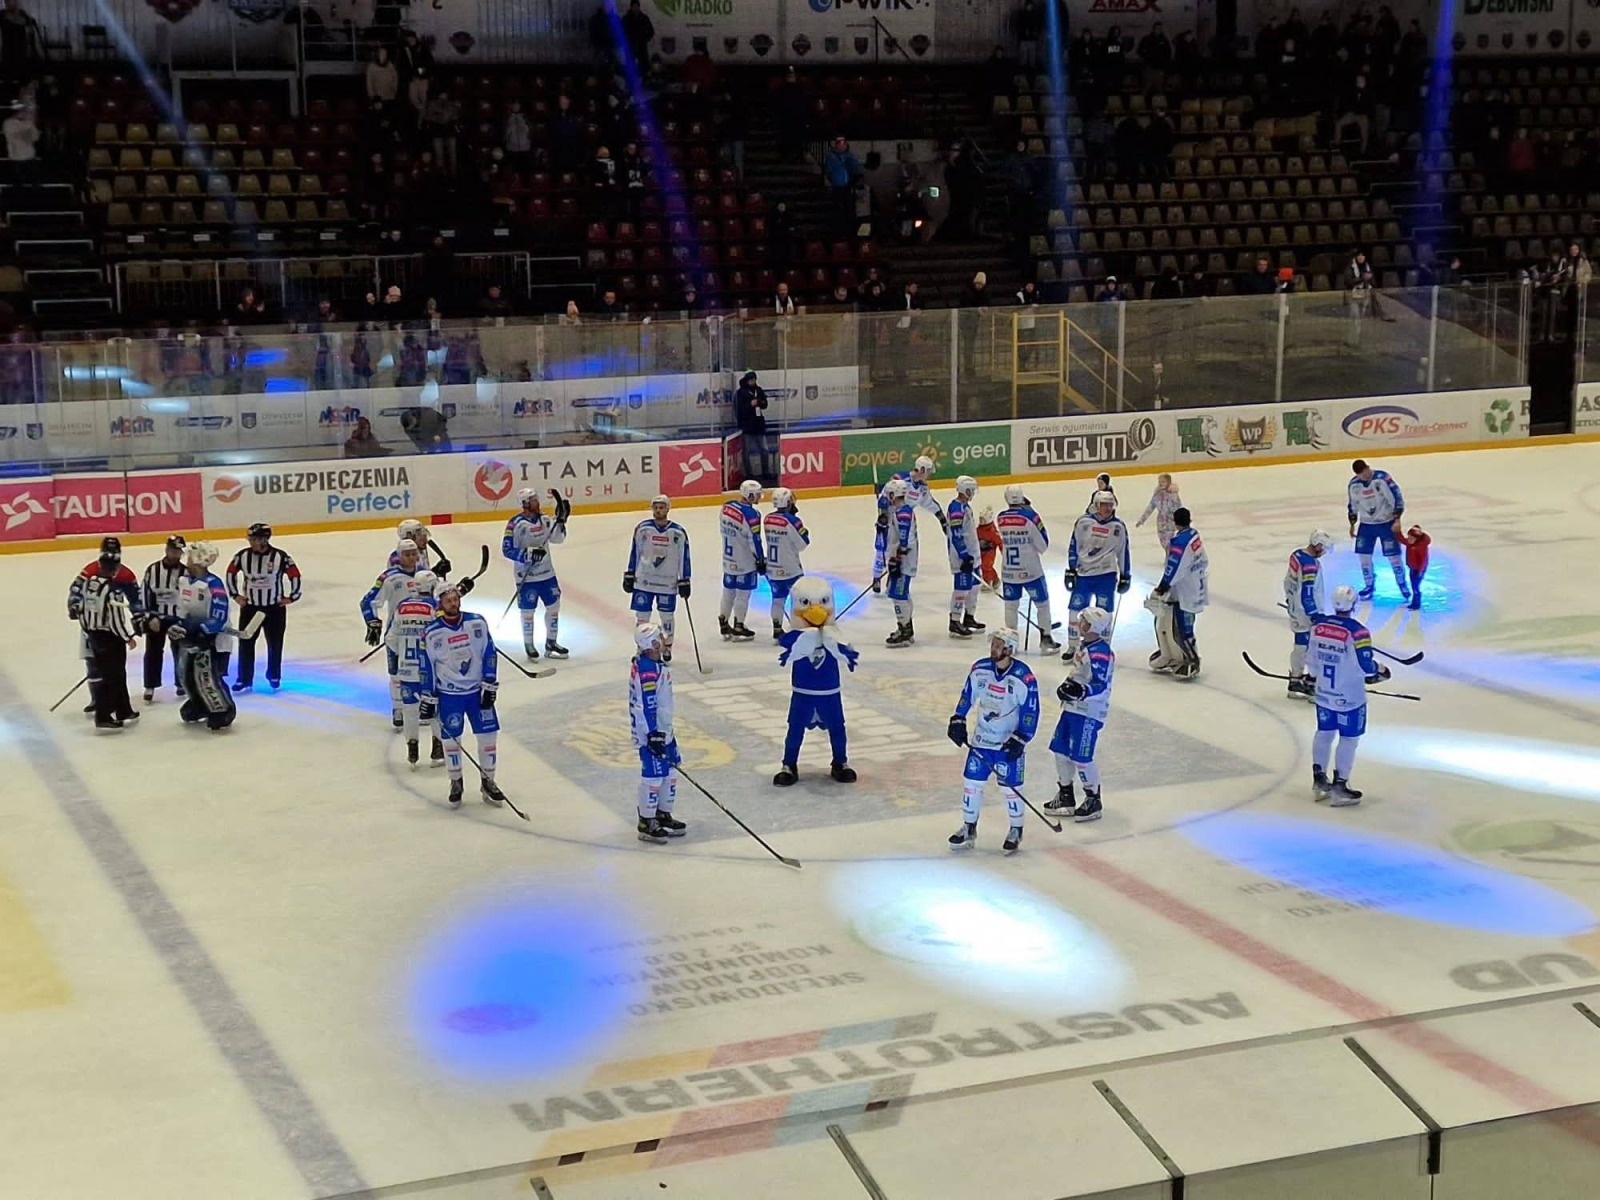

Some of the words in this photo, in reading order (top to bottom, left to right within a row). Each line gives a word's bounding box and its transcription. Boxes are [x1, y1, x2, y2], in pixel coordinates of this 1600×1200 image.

[684, 0, 732, 15] RADKO
[1029, 424, 1060, 435] Serwis
[1062, 420, 1109, 435] ogumienia
[1242, 427, 1262, 441] WP
[1359, 417, 1401, 436] PKS
[521, 455, 654, 480] ITAMAE
[845, 447, 905, 469] power
[952, 442, 1006, 464] green
[254, 467, 410, 496] UBEZPIECZENIA
[547, 482, 630, 499] SUSHI
[50, 490, 182, 519] TAURON
[327, 489, 411, 514] Perfect
[1006, 546, 1020, 566] 12
[1323, 664, 1336, 690] 9
[587, 944, 834, 988] KOMUNALNYCH
[509, 991, 1251, 1135] AUSTROTHERM
